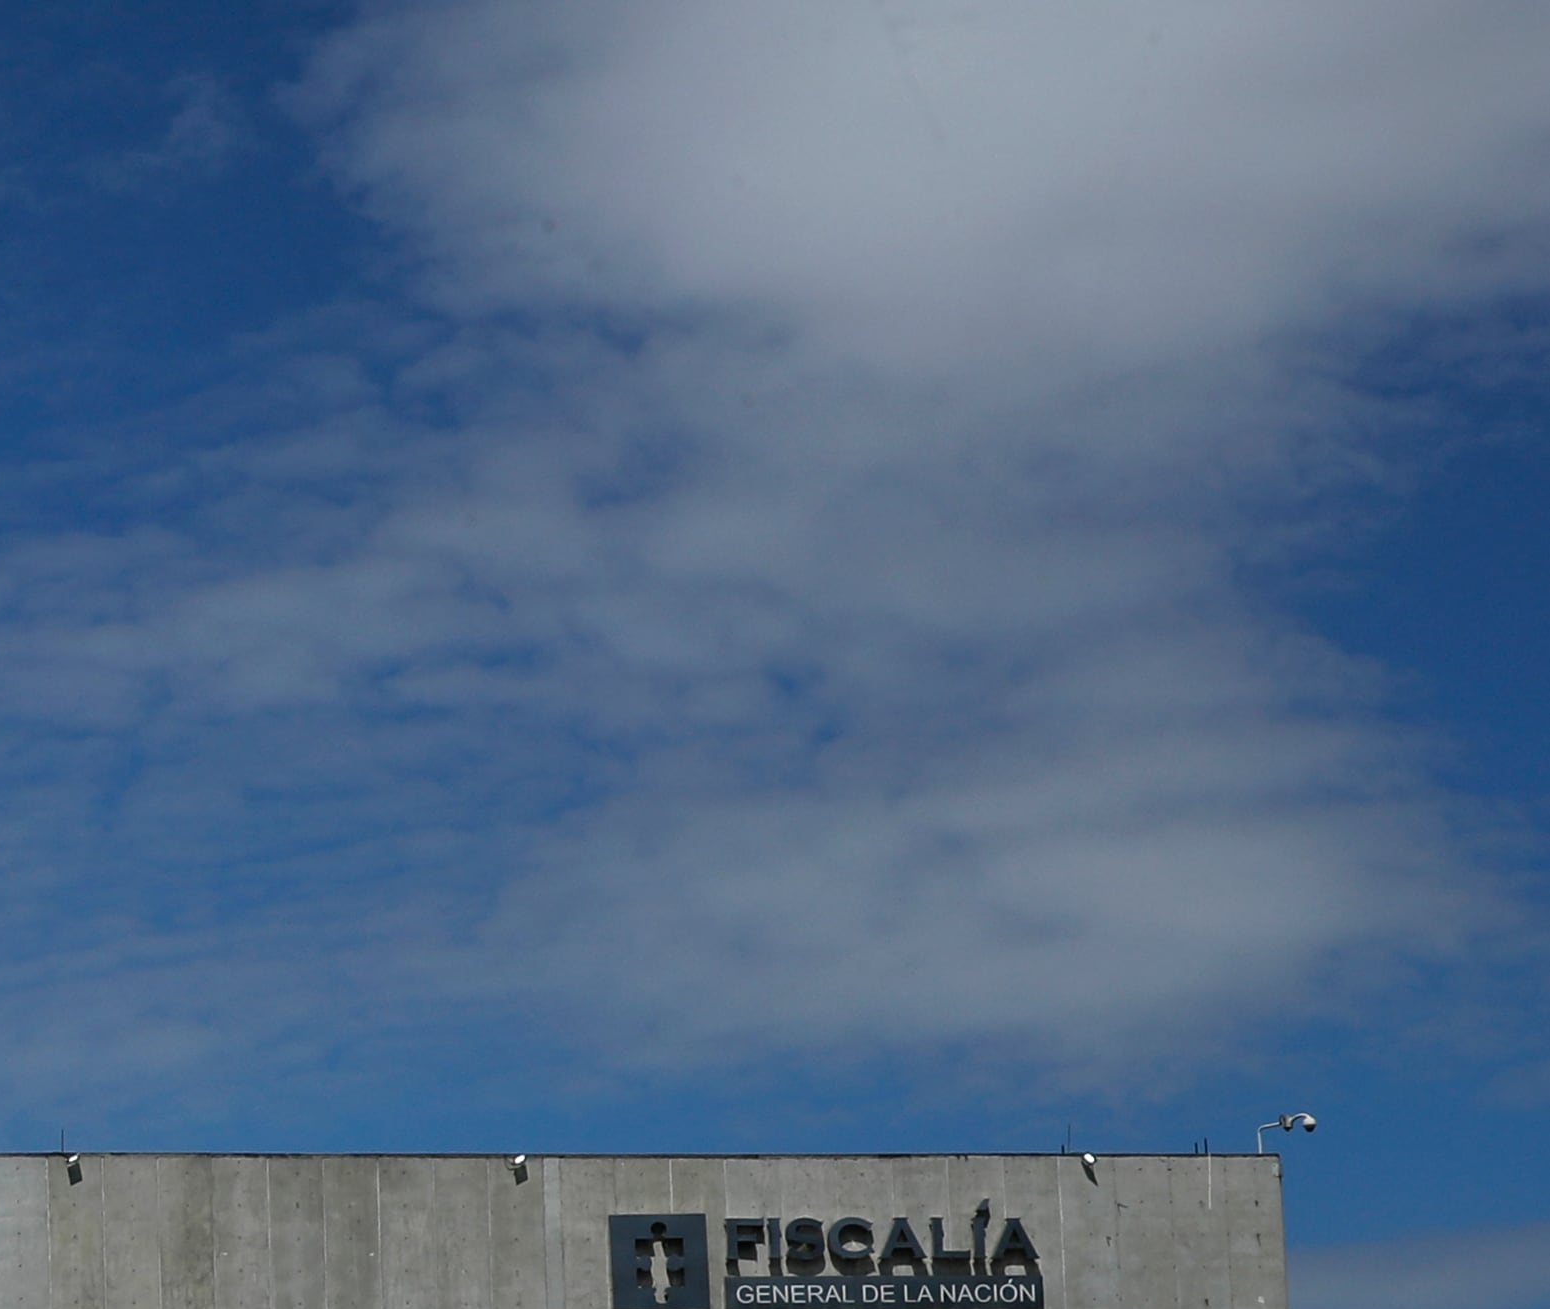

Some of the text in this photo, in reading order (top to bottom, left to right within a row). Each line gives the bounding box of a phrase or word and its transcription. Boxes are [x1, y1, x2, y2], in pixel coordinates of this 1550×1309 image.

[724, 1198, 1040, 1260] FISCALÍA
[735, 1278, 1036, 1304] GENERAL DE LA NACIÓN
